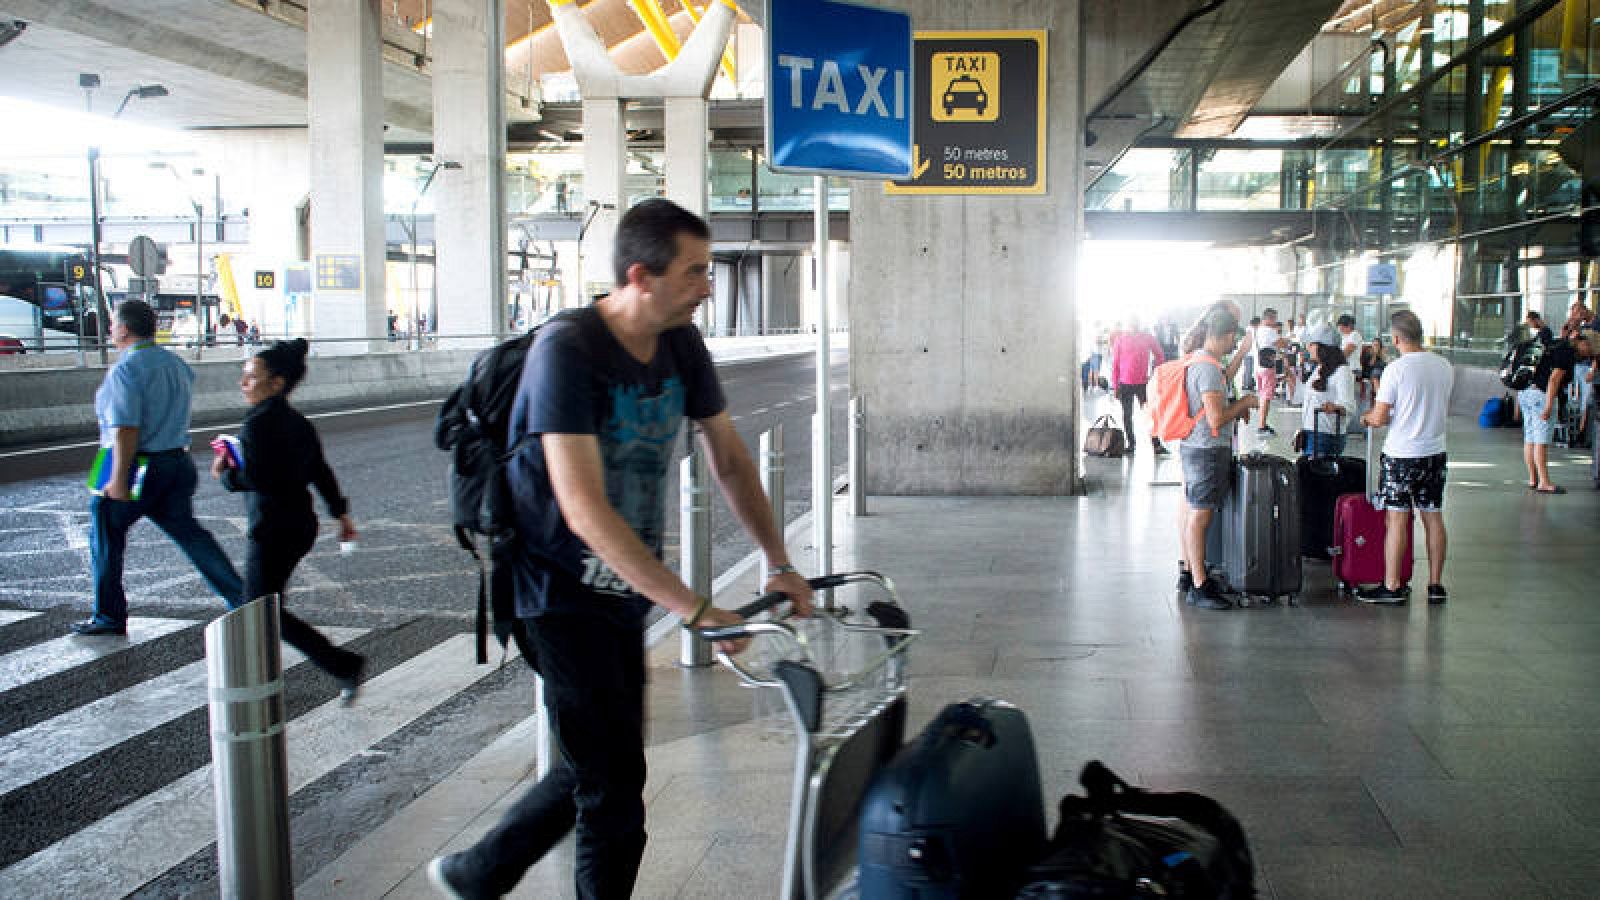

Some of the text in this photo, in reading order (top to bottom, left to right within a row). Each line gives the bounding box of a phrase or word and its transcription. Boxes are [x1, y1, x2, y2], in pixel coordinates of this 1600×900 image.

[944, 56, 986, 72] TAXI
[778, 54, 905, 119] TAXI
[944, 147, 1008, 161] 50 metres
[944, 164, 1027, 180] 50 metros
[73, 265, 85, 279] 9
[257, 275, 273, 287] 10
